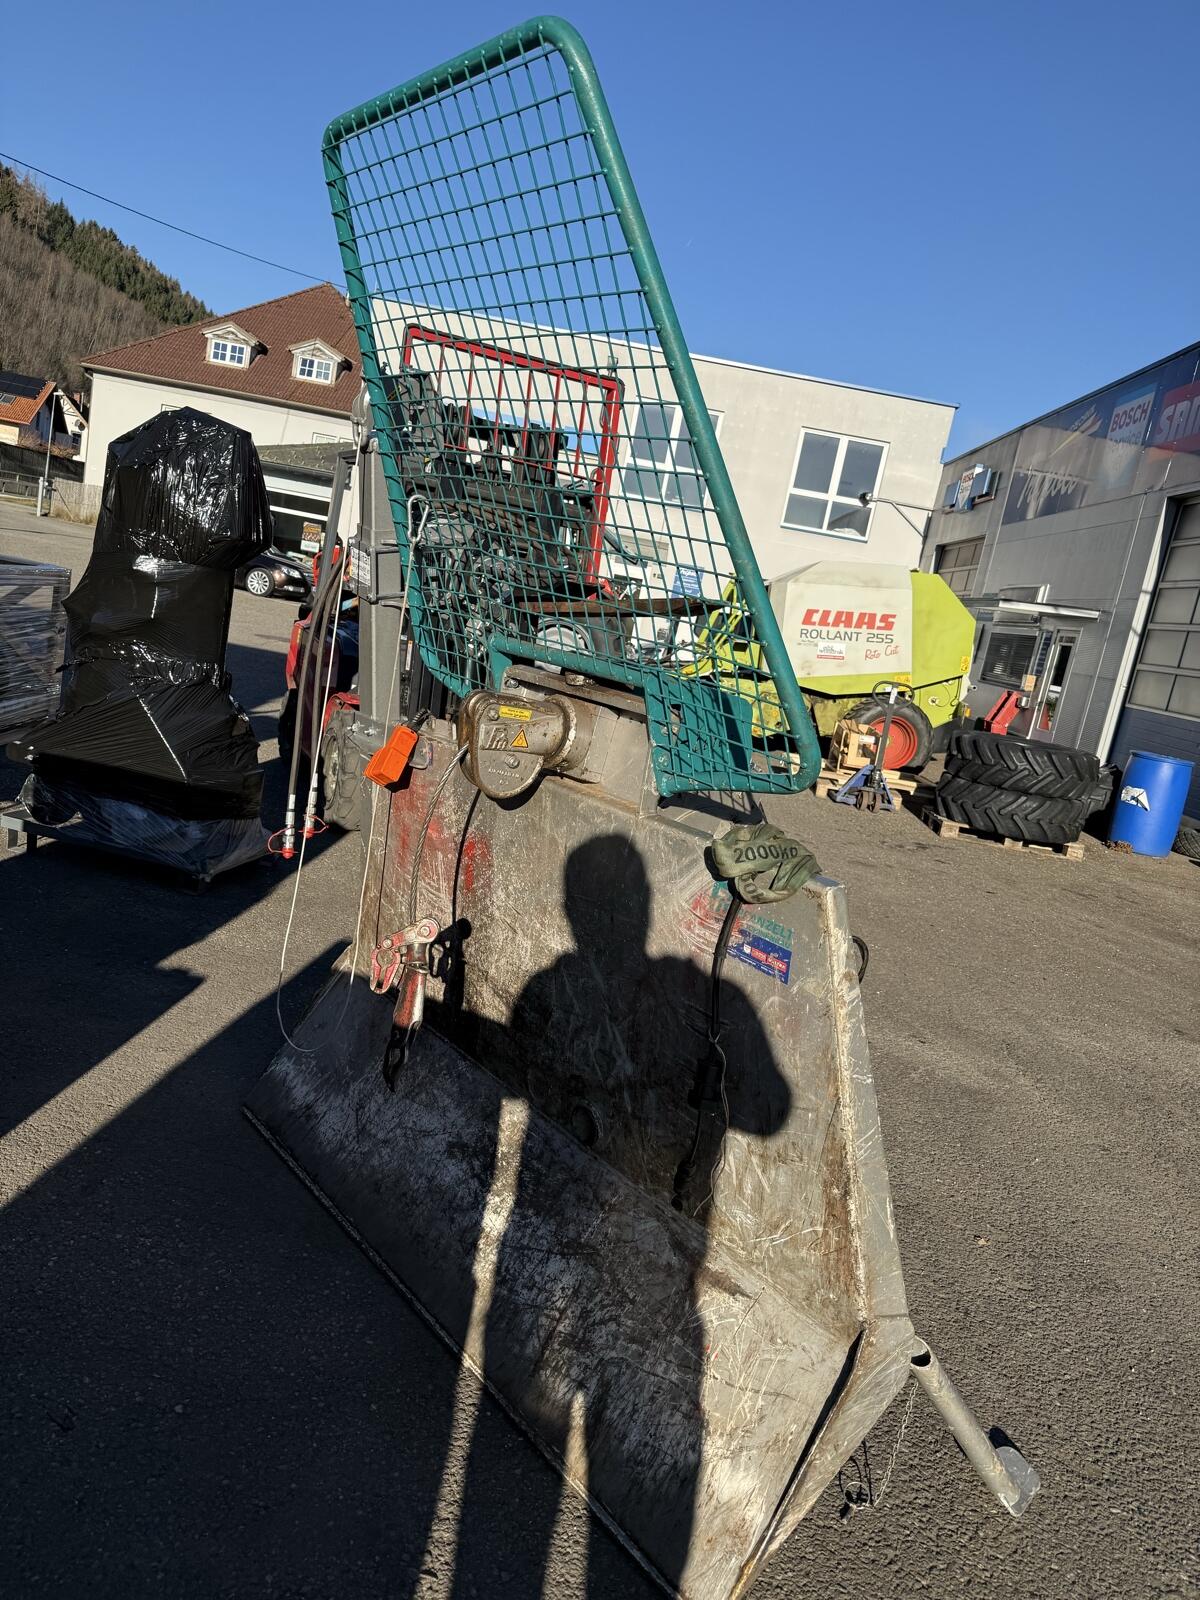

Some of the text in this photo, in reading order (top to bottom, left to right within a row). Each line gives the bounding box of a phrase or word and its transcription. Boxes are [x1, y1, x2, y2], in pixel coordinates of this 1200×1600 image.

[1111, 401, 1151, 433] BOSCH
[801, 609, 897, 631] CLAAS
[799, 629, 894, 643] ROLLANT 255
[864, 645, 900, 661] Roto Cut
